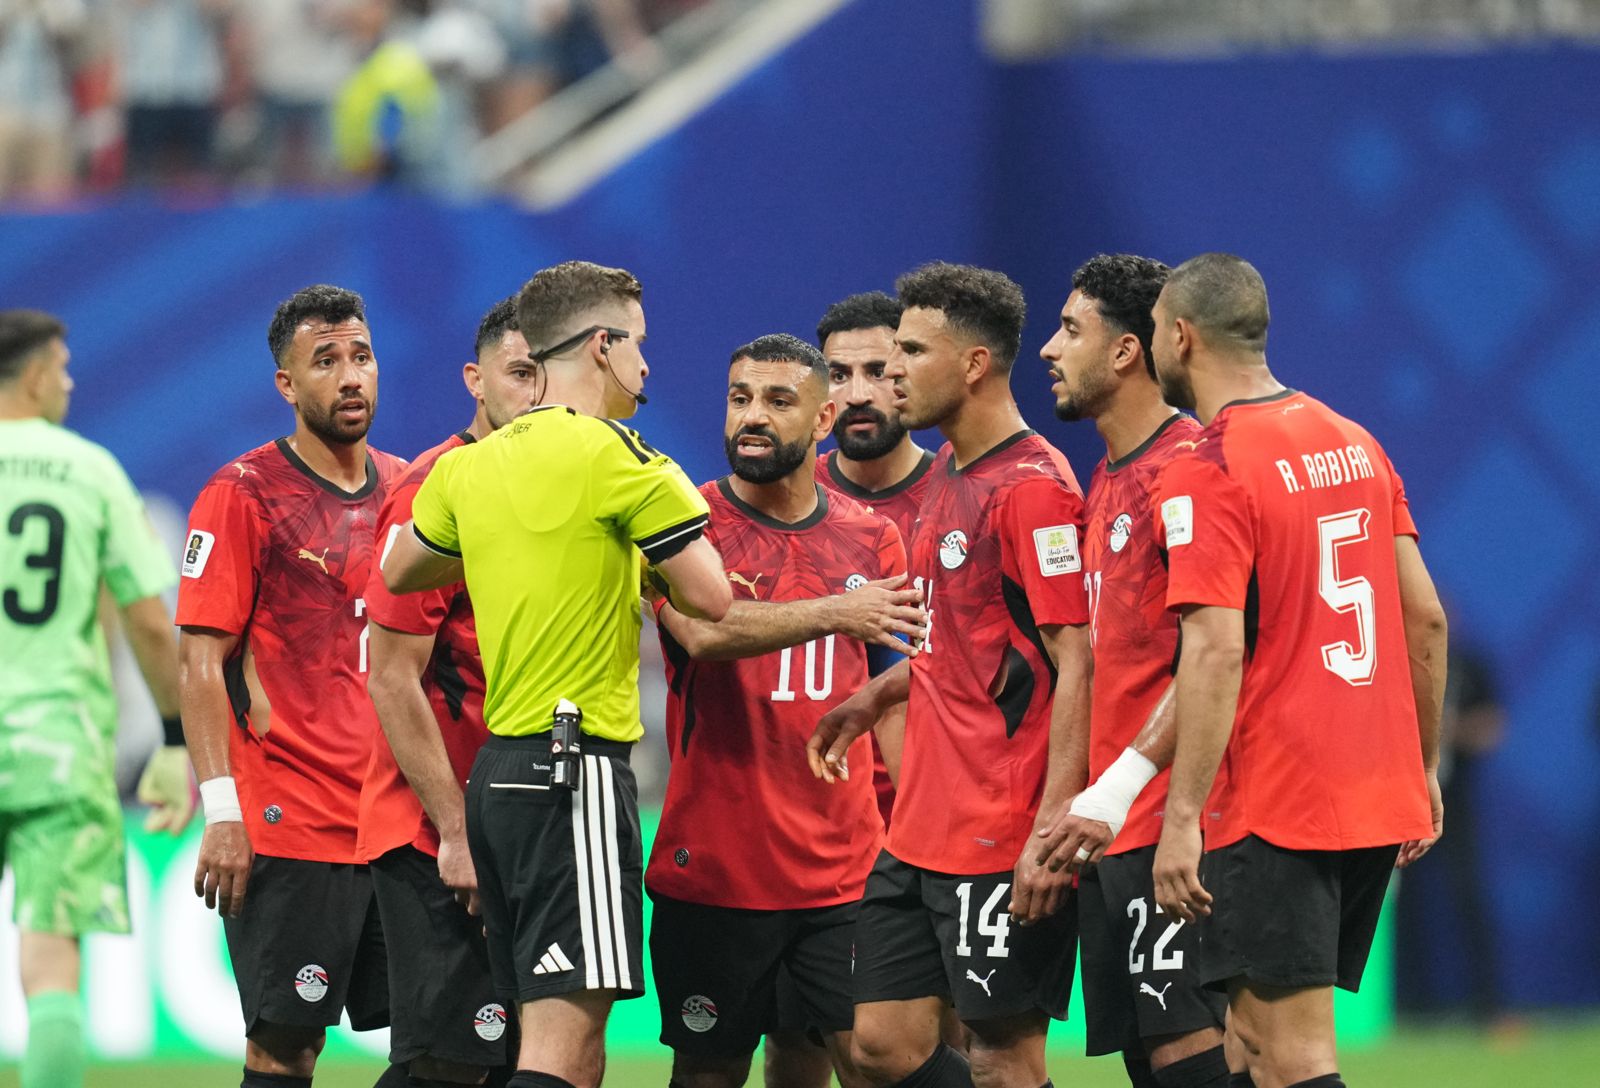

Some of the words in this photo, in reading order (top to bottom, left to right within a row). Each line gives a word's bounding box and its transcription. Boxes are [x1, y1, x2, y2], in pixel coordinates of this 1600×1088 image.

[1275, 459, 1305, 494] R.
[1301, 445, 1375, 489] RABIAA
[3, 502, 66, 626] 3
[1046, 555, 1075, 565] EDUCATION
[1317, 508, 1377, 686] 5
[771, 634, 835, 701] 10
[955, 882, 1010, 958] 14
[1126, 897, 1186, 975] 22
